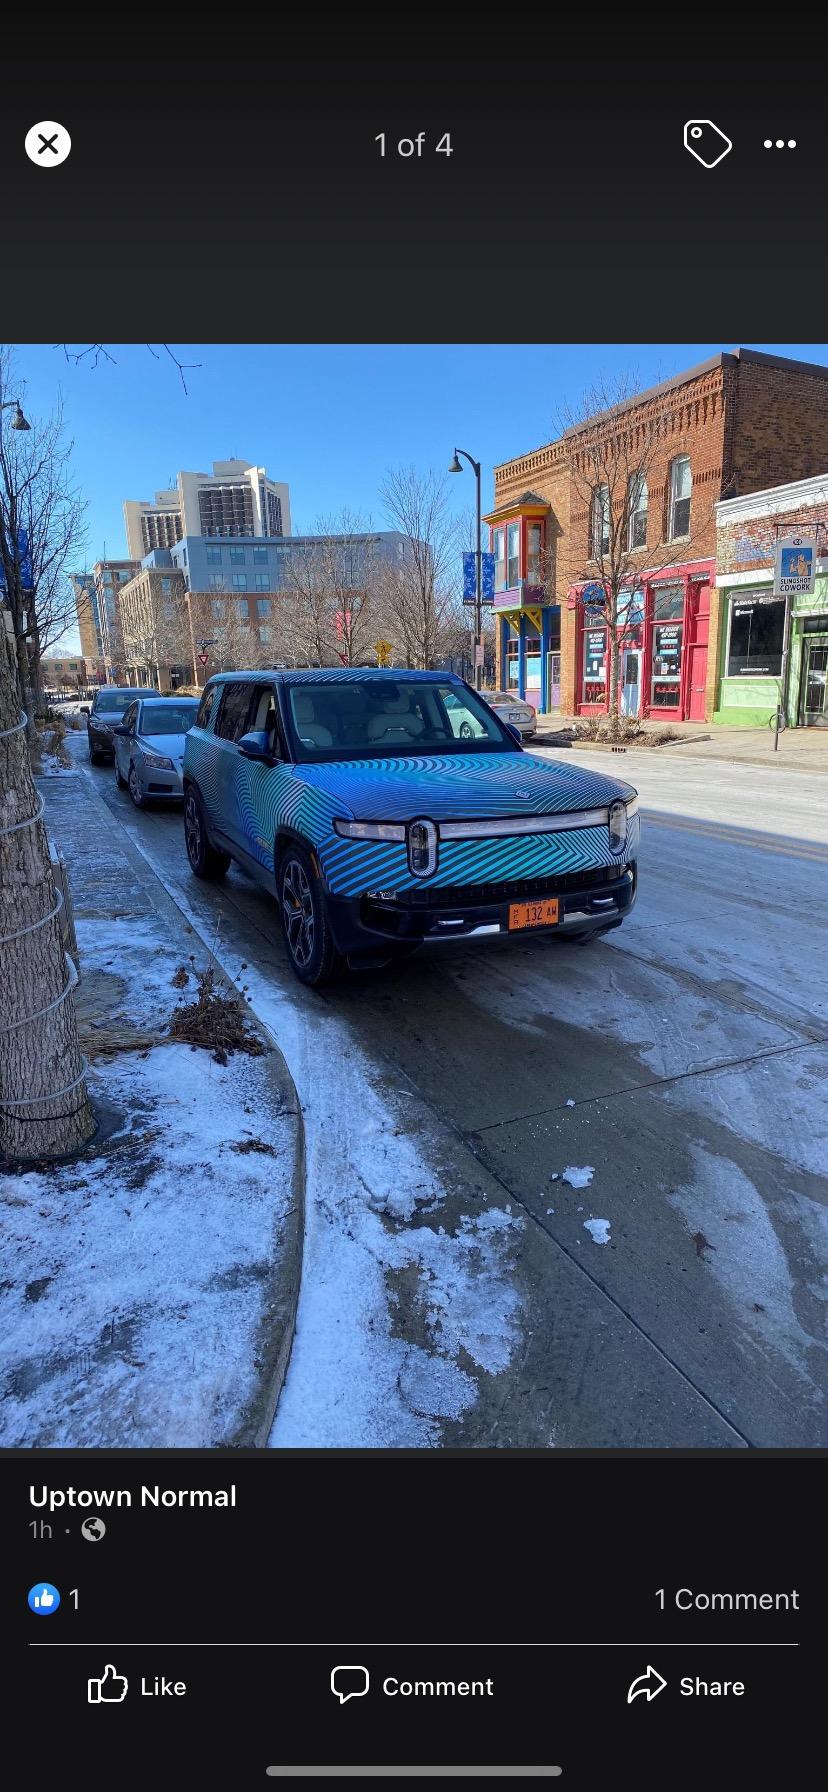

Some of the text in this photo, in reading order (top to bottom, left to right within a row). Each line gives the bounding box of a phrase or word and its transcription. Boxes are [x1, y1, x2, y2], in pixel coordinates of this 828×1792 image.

[780, 577, 811, 585] SLINGSHOT
[780, 584, 810, 592] COWORK
[525, 906, 543, 922] 132
